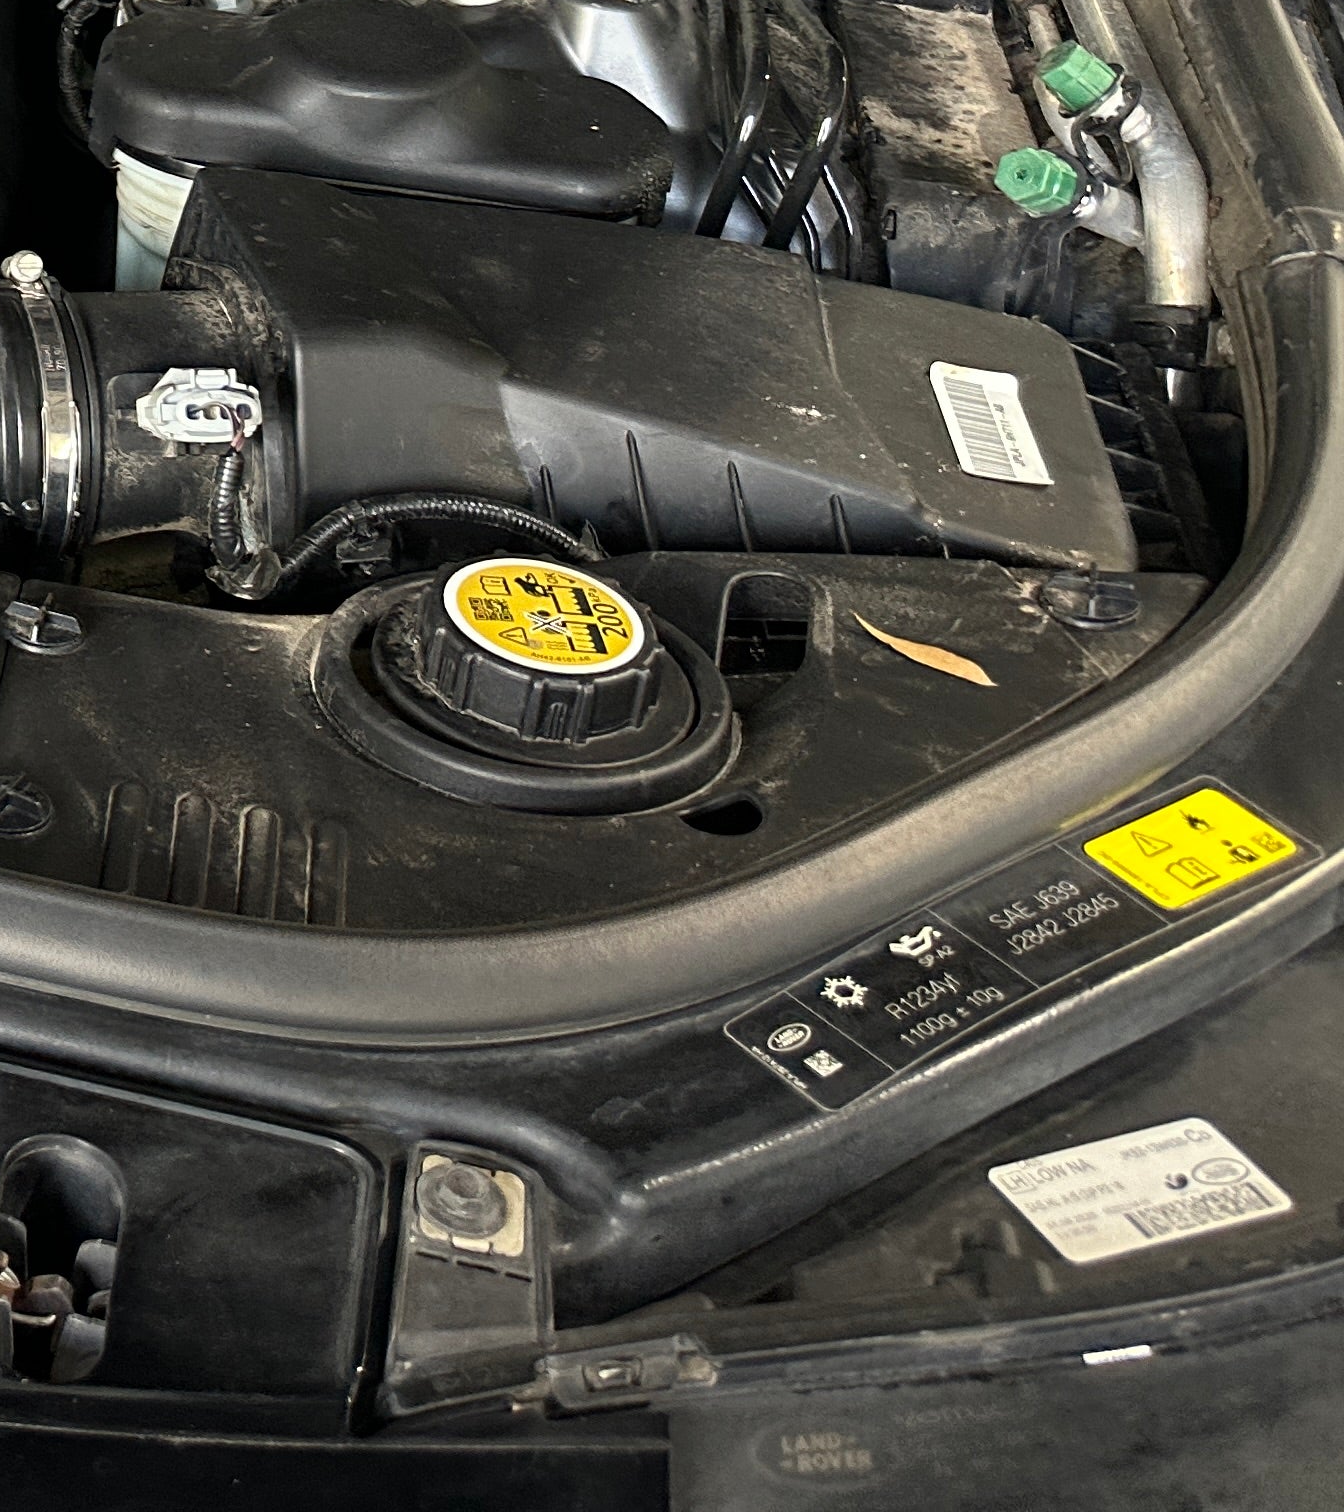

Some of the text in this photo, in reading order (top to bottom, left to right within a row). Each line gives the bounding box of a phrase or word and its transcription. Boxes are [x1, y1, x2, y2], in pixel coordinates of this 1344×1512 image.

[592, 603, 629, 640] 200
[988, 879, 1081, 930] SAE J639
[1005, 891, 1120, 956] J2842 J2845
[883, 971, 961, 1021] R1234yf
[899, 1012, 959, 1046] 1100g
[965, 986, 1005, 1008] 10g
[1000, 1173, 1028, 1191] LH
[1028, 1162, 1069, 1186] LOW
[1063, 1157, 1098, 1176] NA
[781, 1432, 842, 1455] LAND
